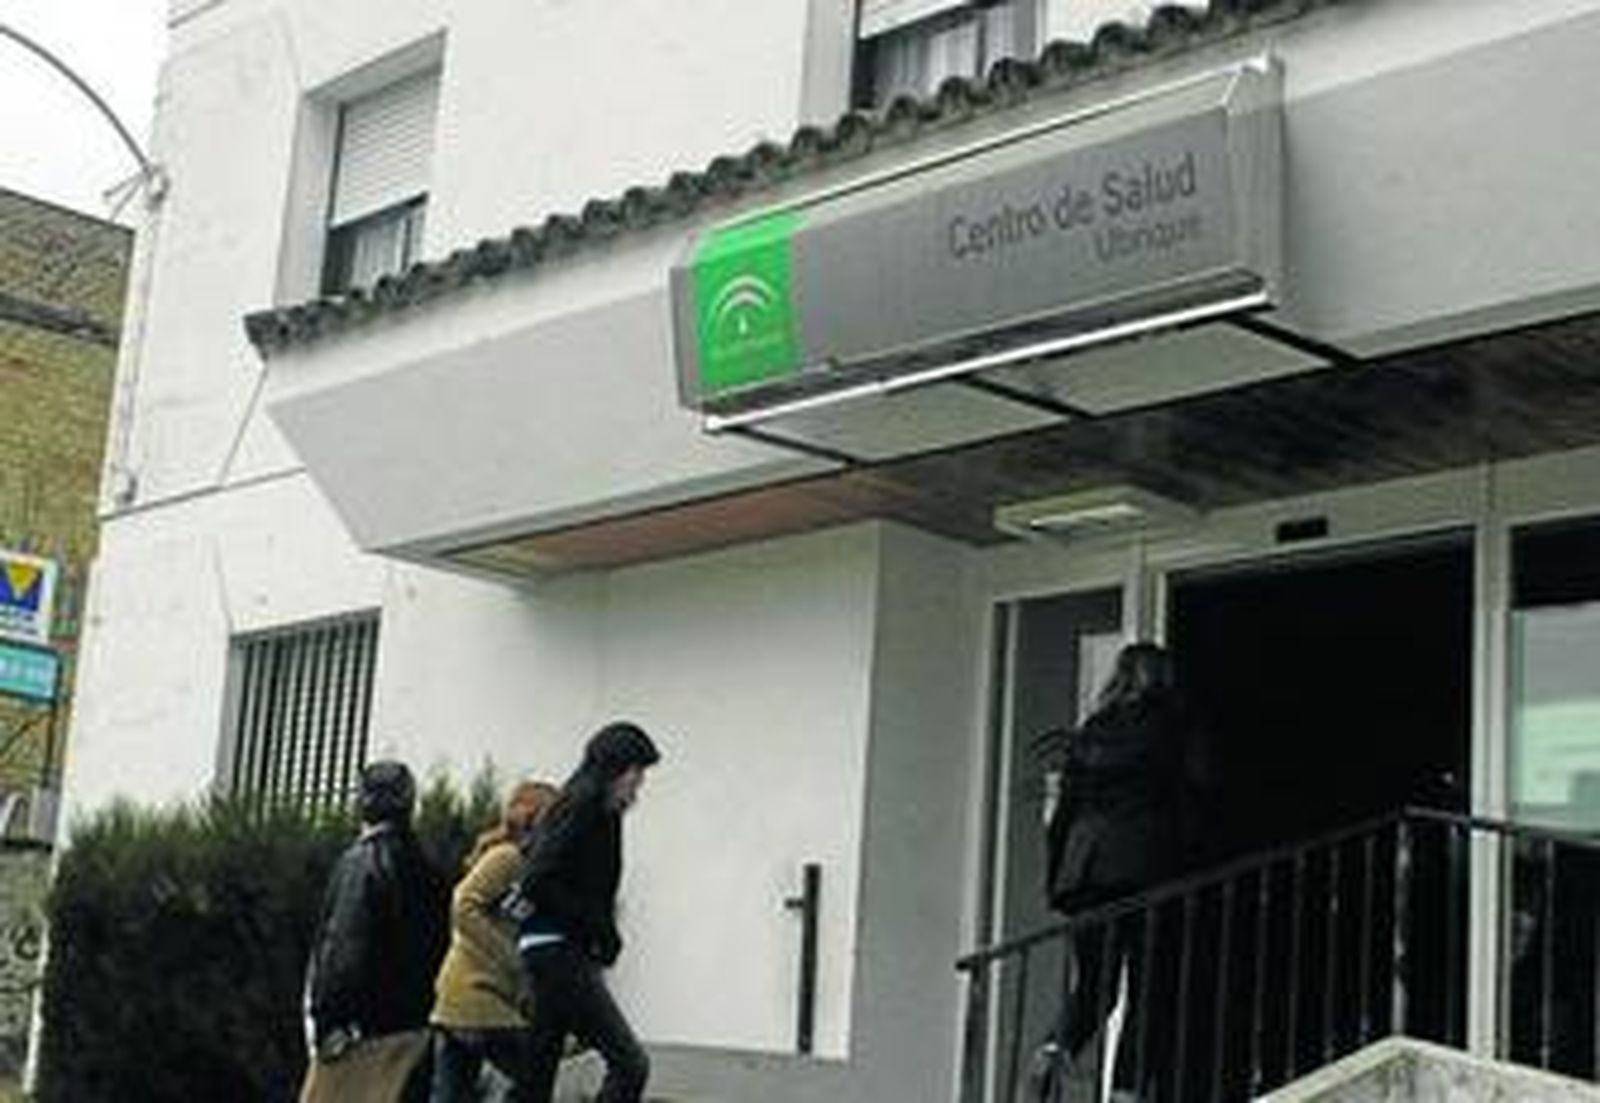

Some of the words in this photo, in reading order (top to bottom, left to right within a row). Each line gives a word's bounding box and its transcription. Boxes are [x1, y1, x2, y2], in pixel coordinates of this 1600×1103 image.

[949, 202, 1046, 260] Centro
[1053, 186, 1095, 231] de
[1103, 153, 1196, 216] Salud
